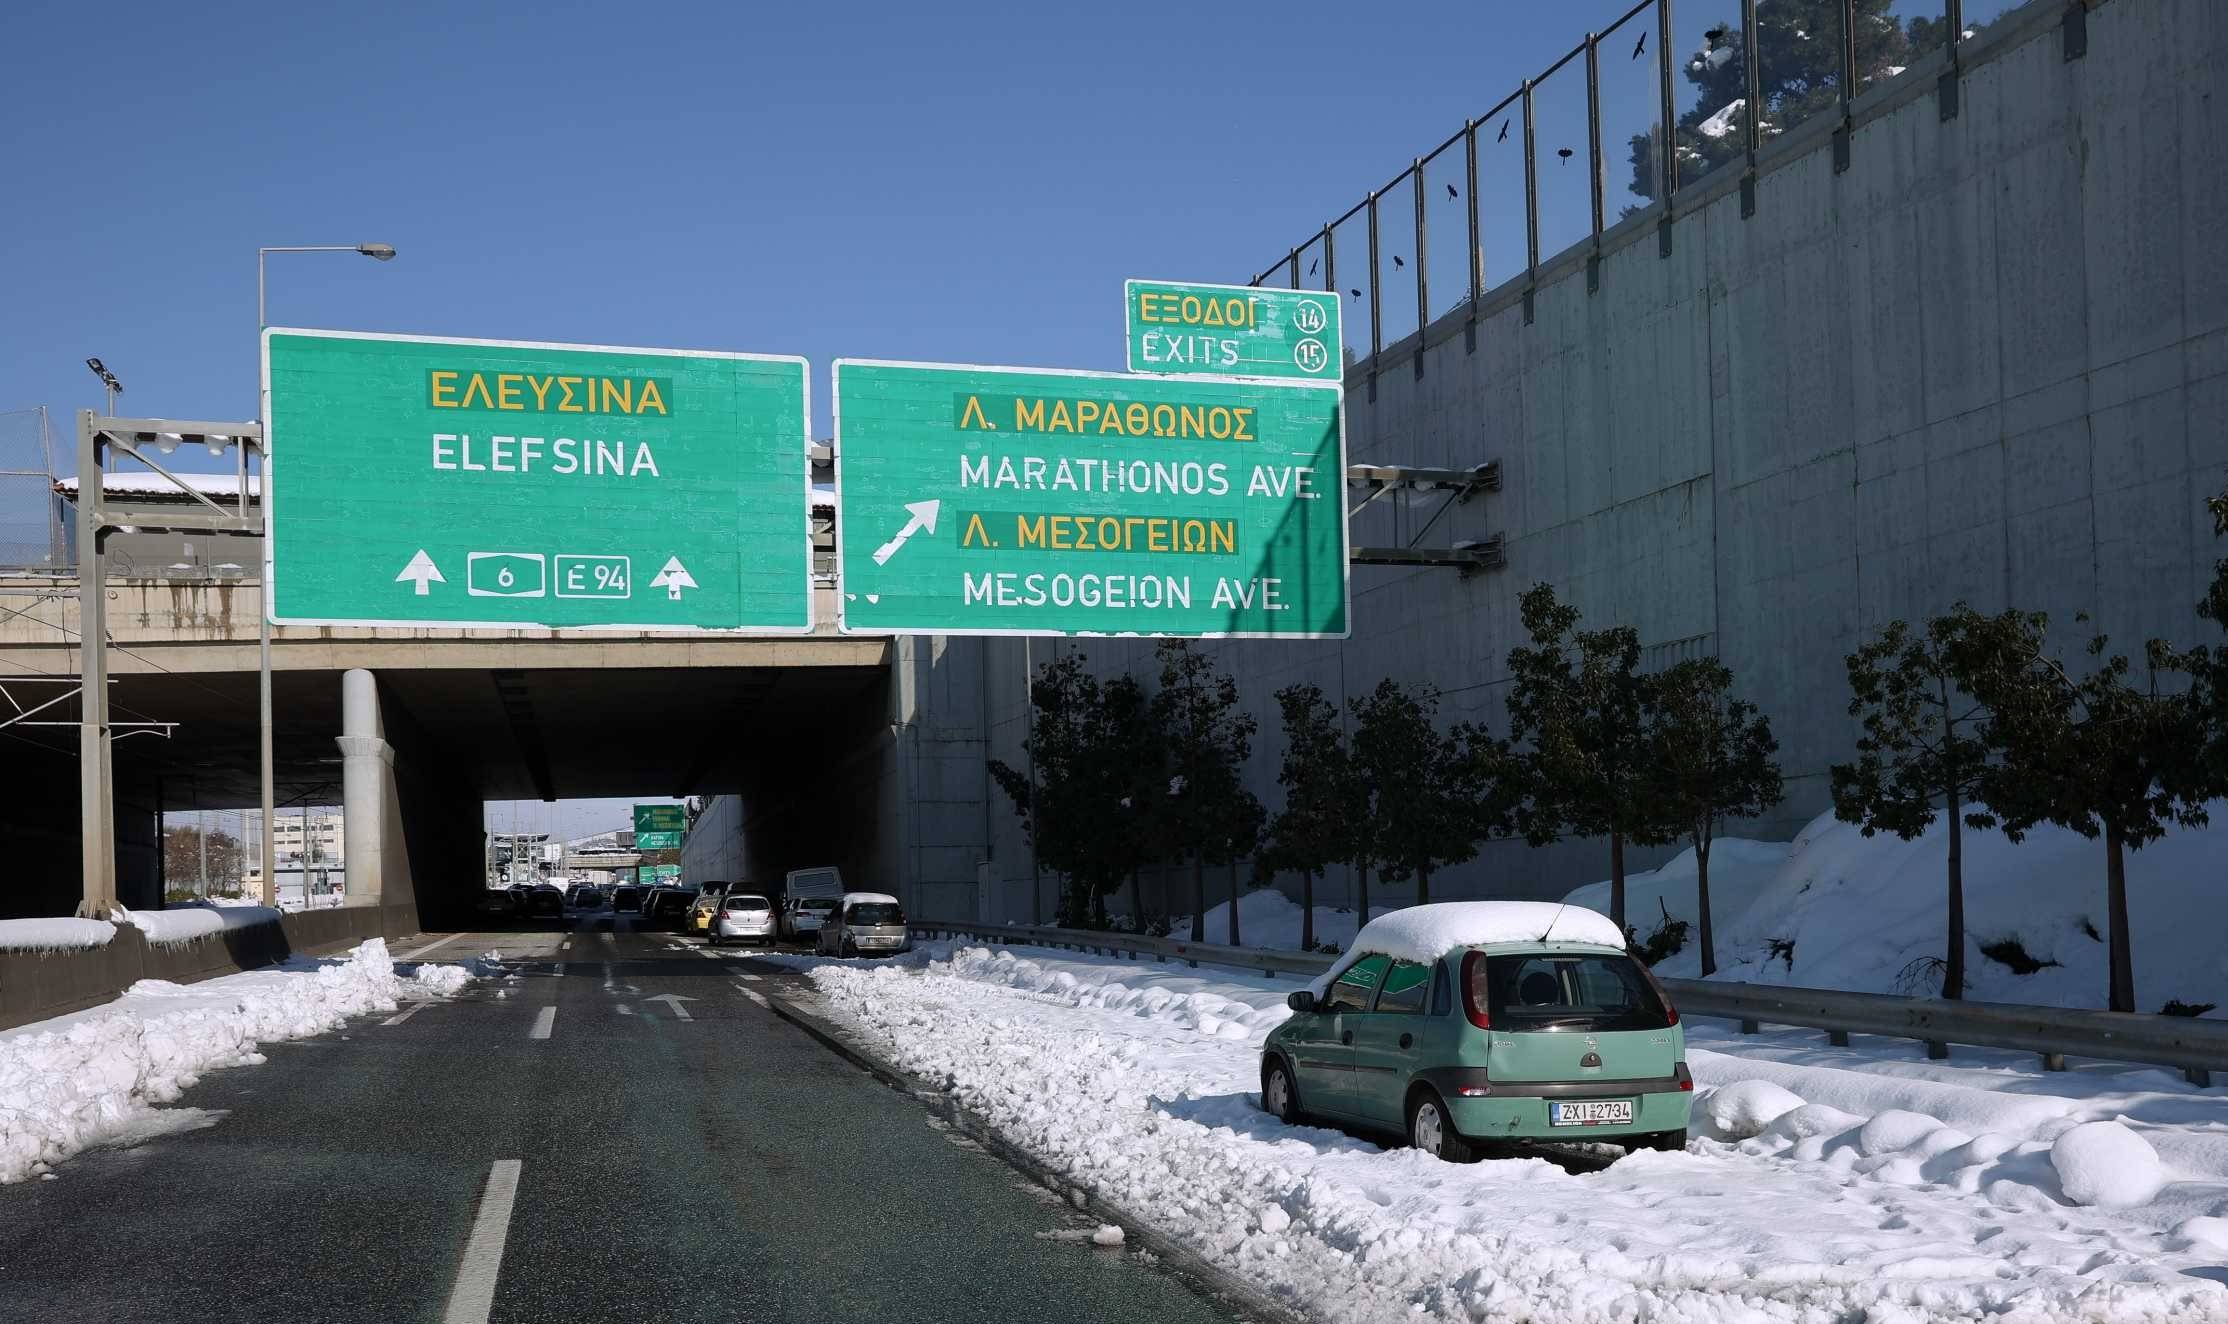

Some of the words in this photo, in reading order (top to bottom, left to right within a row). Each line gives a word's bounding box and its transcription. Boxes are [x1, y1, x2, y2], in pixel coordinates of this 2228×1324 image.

[1141, 293, 1257, 331] ΕΞΟΔΟΙ
[1299, 308, 1320, 330] 14
[1142, 332, 1240, 366] EXITS
[1299, 344, 1321, 368] 15
[430, 370, 667, 415] ΕΛΕΥΣΙΝΑ
[961, 396, 997, 430] Λ.
[1016, 398, 1255, 441] ΜΑΡΑΘΩΝΟΣ
[432, 433, 660, 478] ELEFSINA
[961, 454, 1229, 496] MARATHONOS
[1247, 465, 1322, 499] AVE.
[962, 513, 998, 547] Λ.
[1017, 515, 1236, 554] ΜΕΣΟΓΕΙΩΝ
[497, 566, 514, 587] 6
[567, 564, 585, 589] E
[595, 564, 626, 591] 94
[964, 571, 1191, 610] MESOGEION
[1212, 577, 1291, 611] AVE.
